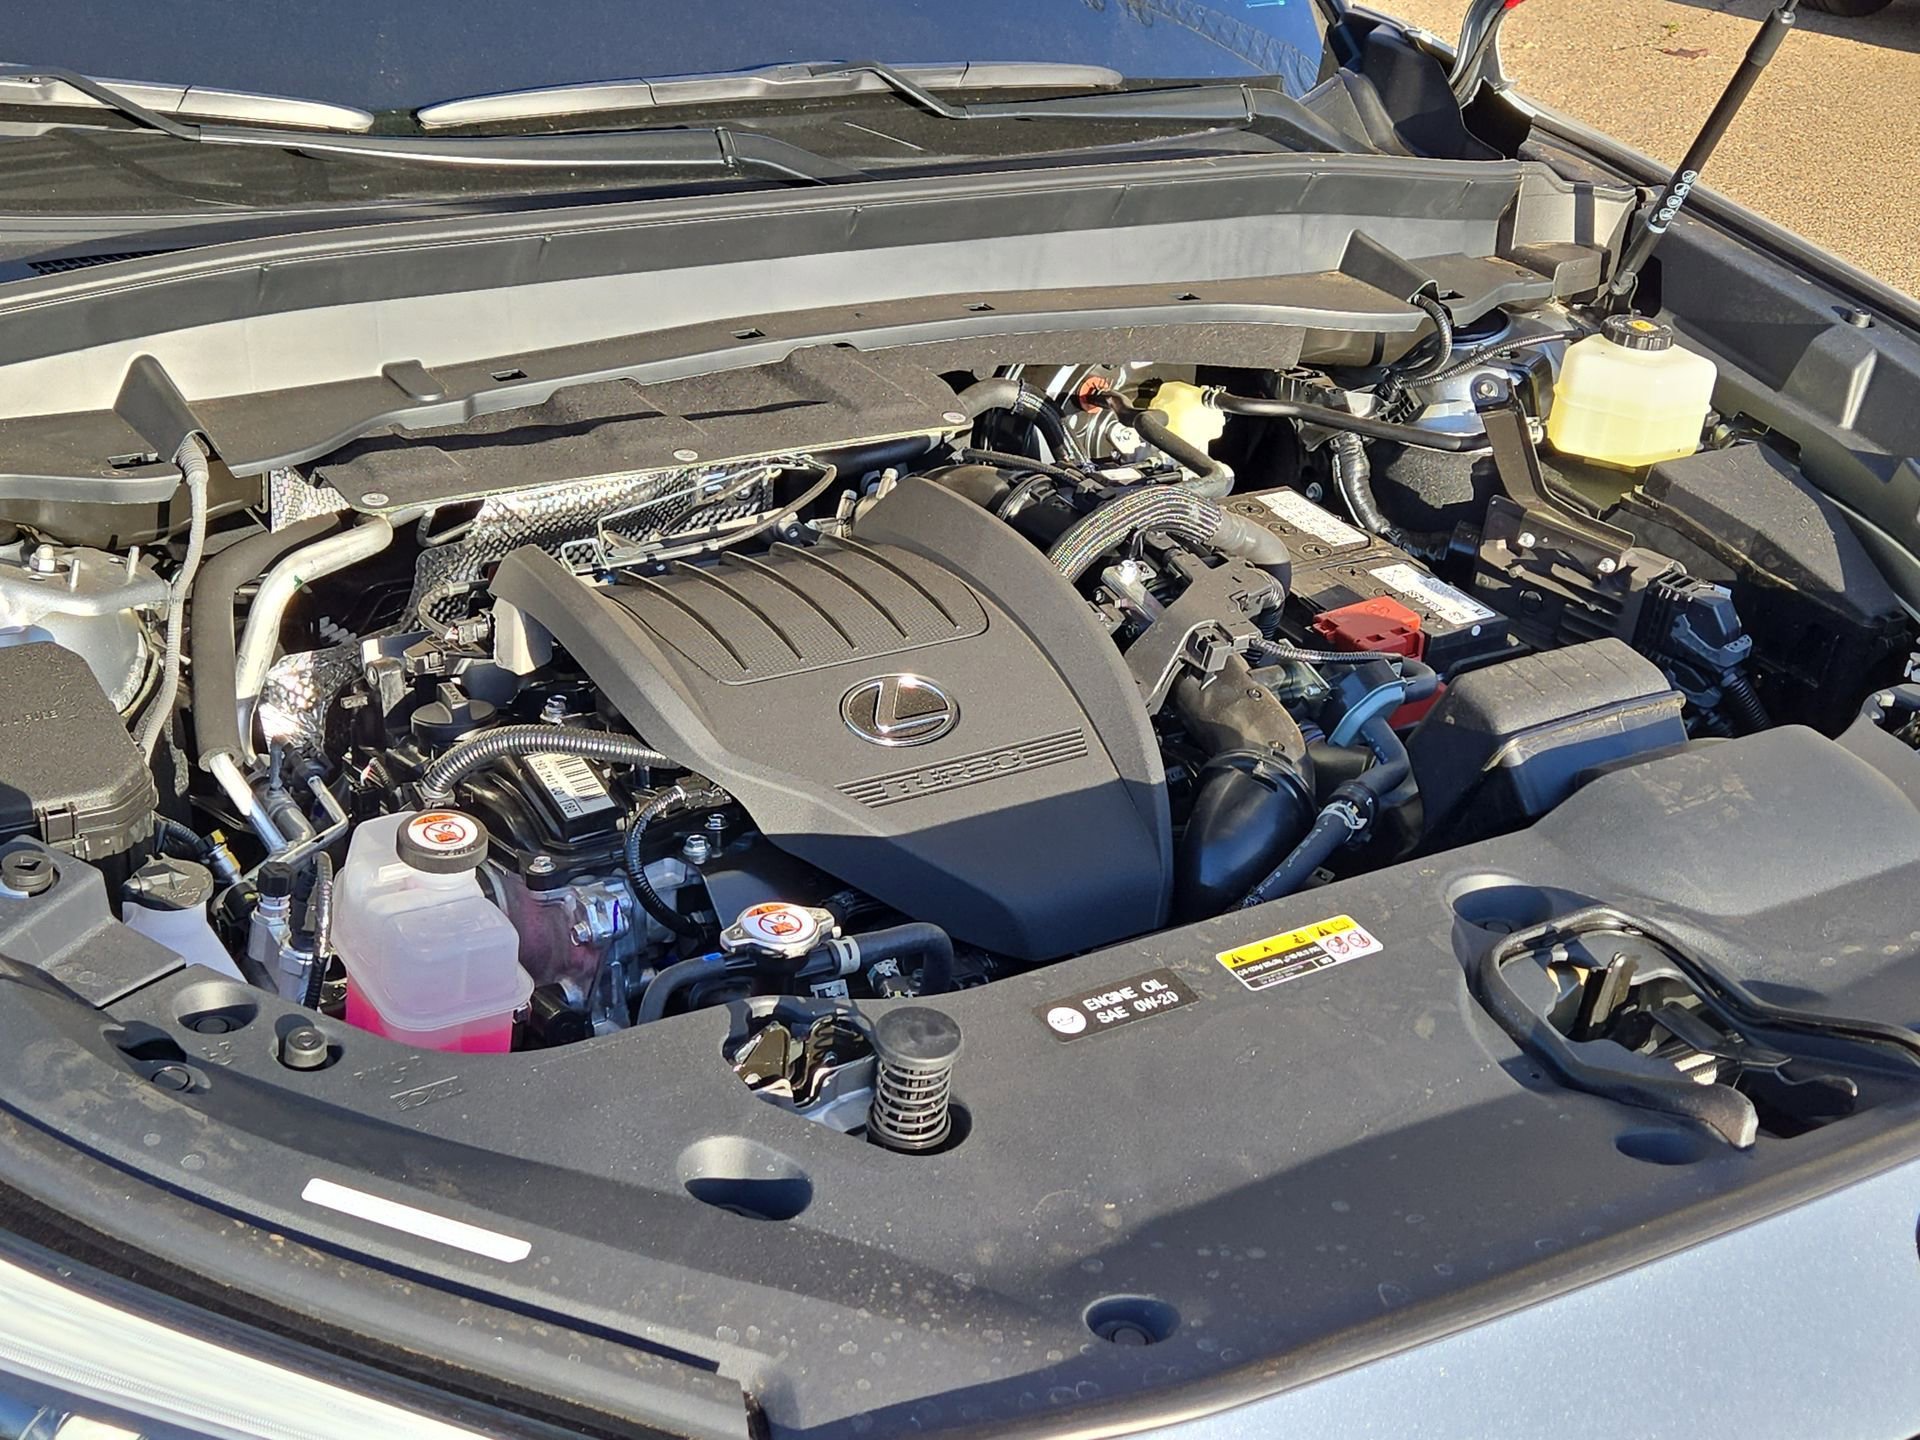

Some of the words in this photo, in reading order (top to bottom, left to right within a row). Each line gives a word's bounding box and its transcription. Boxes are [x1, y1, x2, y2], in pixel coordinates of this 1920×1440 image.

[883, 750, 1022, 794] TURBO
[1082, 986, 1138, 1011] ENGINE
[1141, 979, 1168, 993] OIL
[1096, 1006, 1130, 1024] SAE
[1133, 991, 1179, 1012] 0W-20
